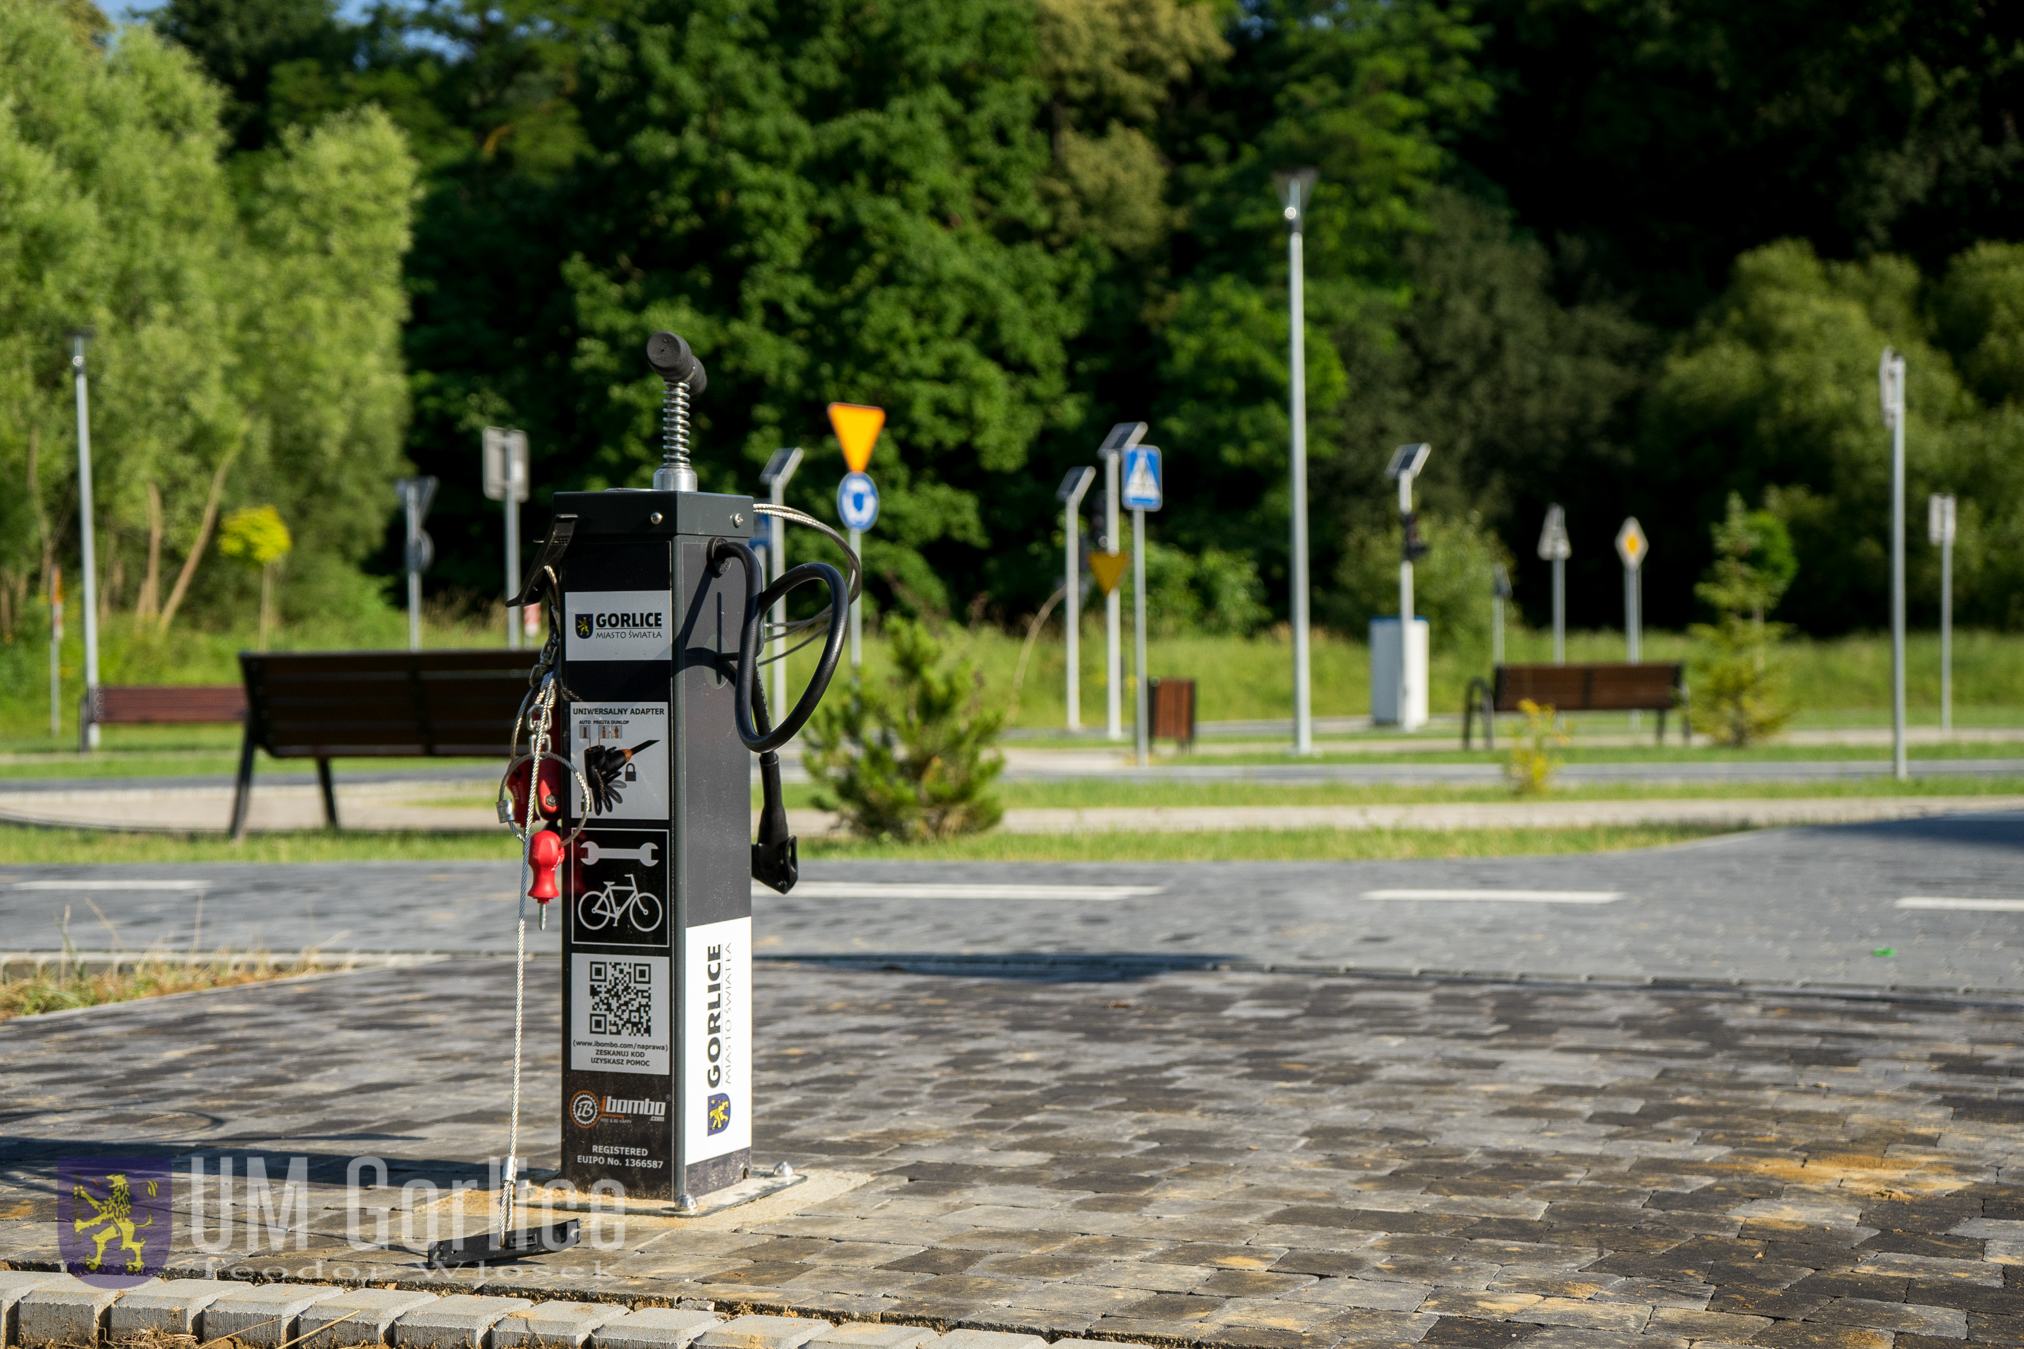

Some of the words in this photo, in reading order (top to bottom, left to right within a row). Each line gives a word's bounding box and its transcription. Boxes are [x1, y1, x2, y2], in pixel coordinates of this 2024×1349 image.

[596, 612, 662, 628] GORLICE
[595, 631, 627, 639] MIASTO
[628, 630, 662, 639] ŚWIATŁA
[723, 942, 732, 1014] ŚWIATŁA
[707, 943, 721, 1089] GORLICE
[573, 1039, 668, 1052] (www.ibombo.com/naprawa)
[595, 1049, 629, 1057] ZESKANUJ
[590, 1057, 625, 1065] UZYSKASZ
[601, 1095, 667, 1116] ibombo
[592, 1145, 648, 1157] REGISTERED
[577, 1155, 605, 1165] EUIPO
[607, 1157, 622, 1166] No.
[625, 1158, 664, 1169] 1366587
